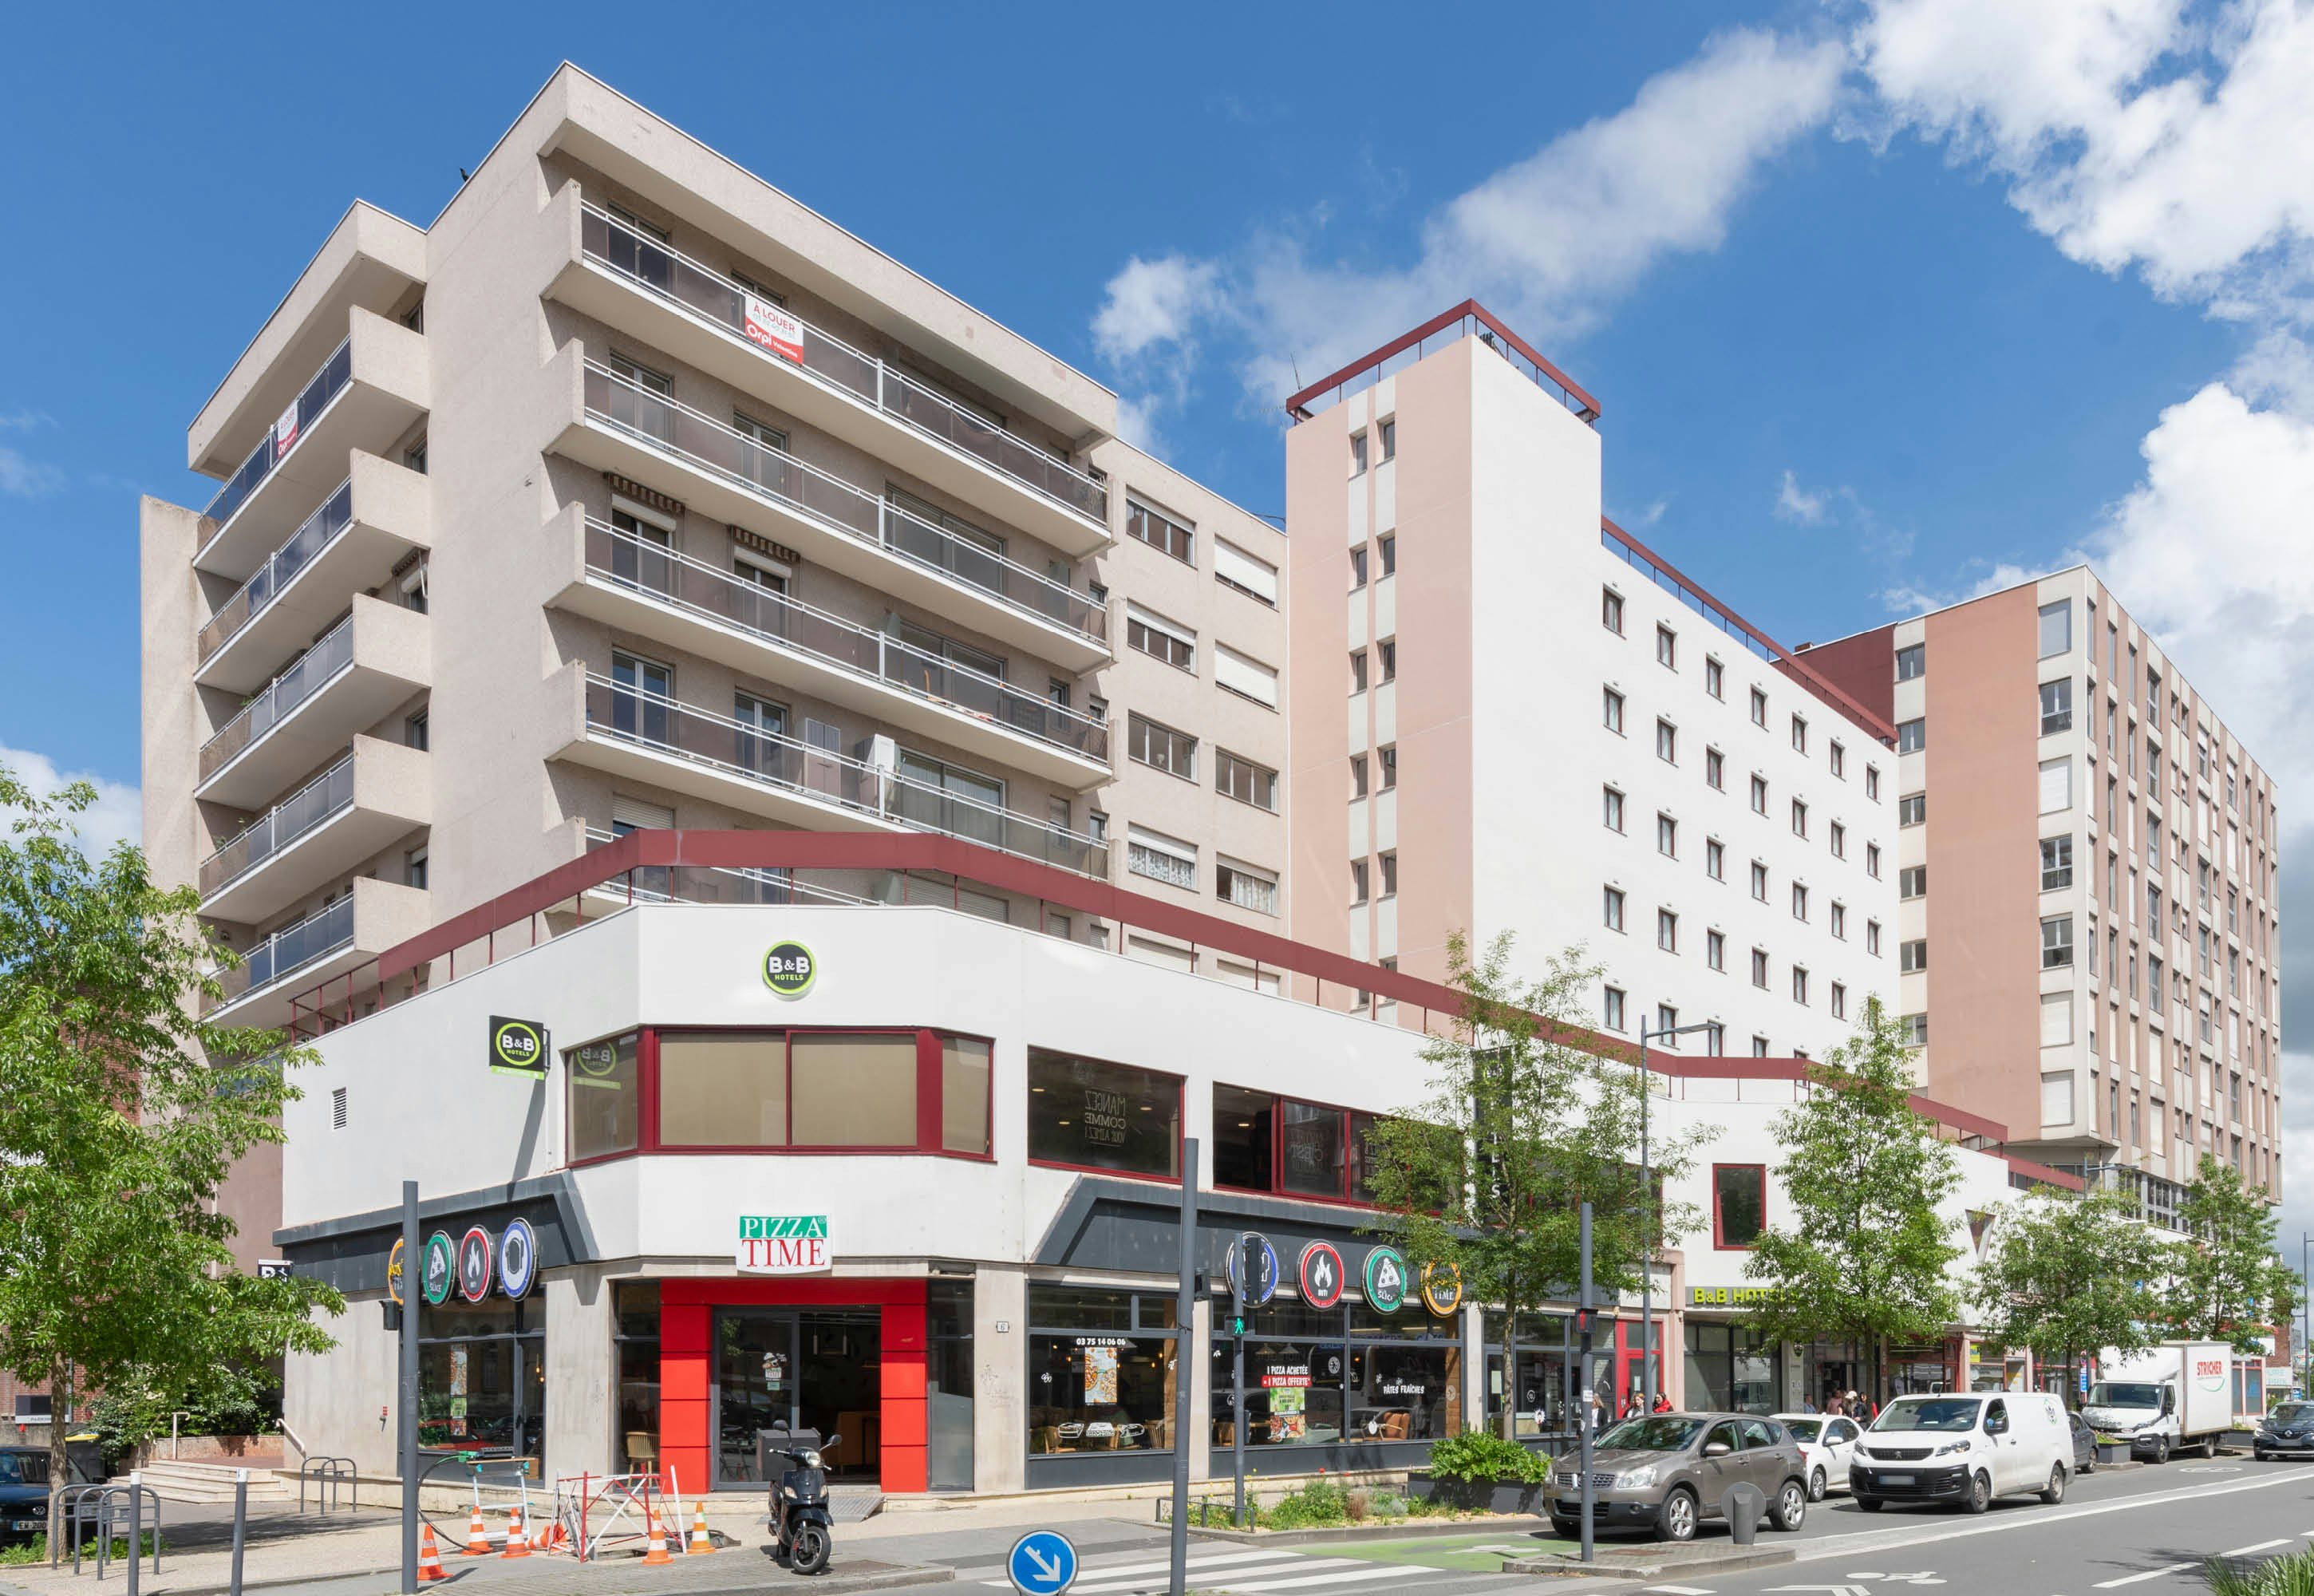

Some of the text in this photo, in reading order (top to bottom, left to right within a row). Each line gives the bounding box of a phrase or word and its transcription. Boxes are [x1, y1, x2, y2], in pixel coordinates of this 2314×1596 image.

[754, 301, 760, 314] À
[763, 307, 796, 333] LOUER
[747, 324, 772, 346] Orpi
[769, 956, 810, 974] B&B
[502, 1034, 535, 1052] B&B
[507, 1049, 530, 1057] HOTELS
[742, 1217, 824, 1238] PIZZA
[741, 1238, 825, 1267] TIME
[1694, 1287, 1728, 1303] B&B
[1270, 1365, 1285, 1375] PIZZA
[1286, 1364, 1309, 1375] ACHETÉE
[1272, 1377, 1287, 1386] PIZZA
[1383, 1383, 1425, 1395] PÂTES FRAÎCHES
